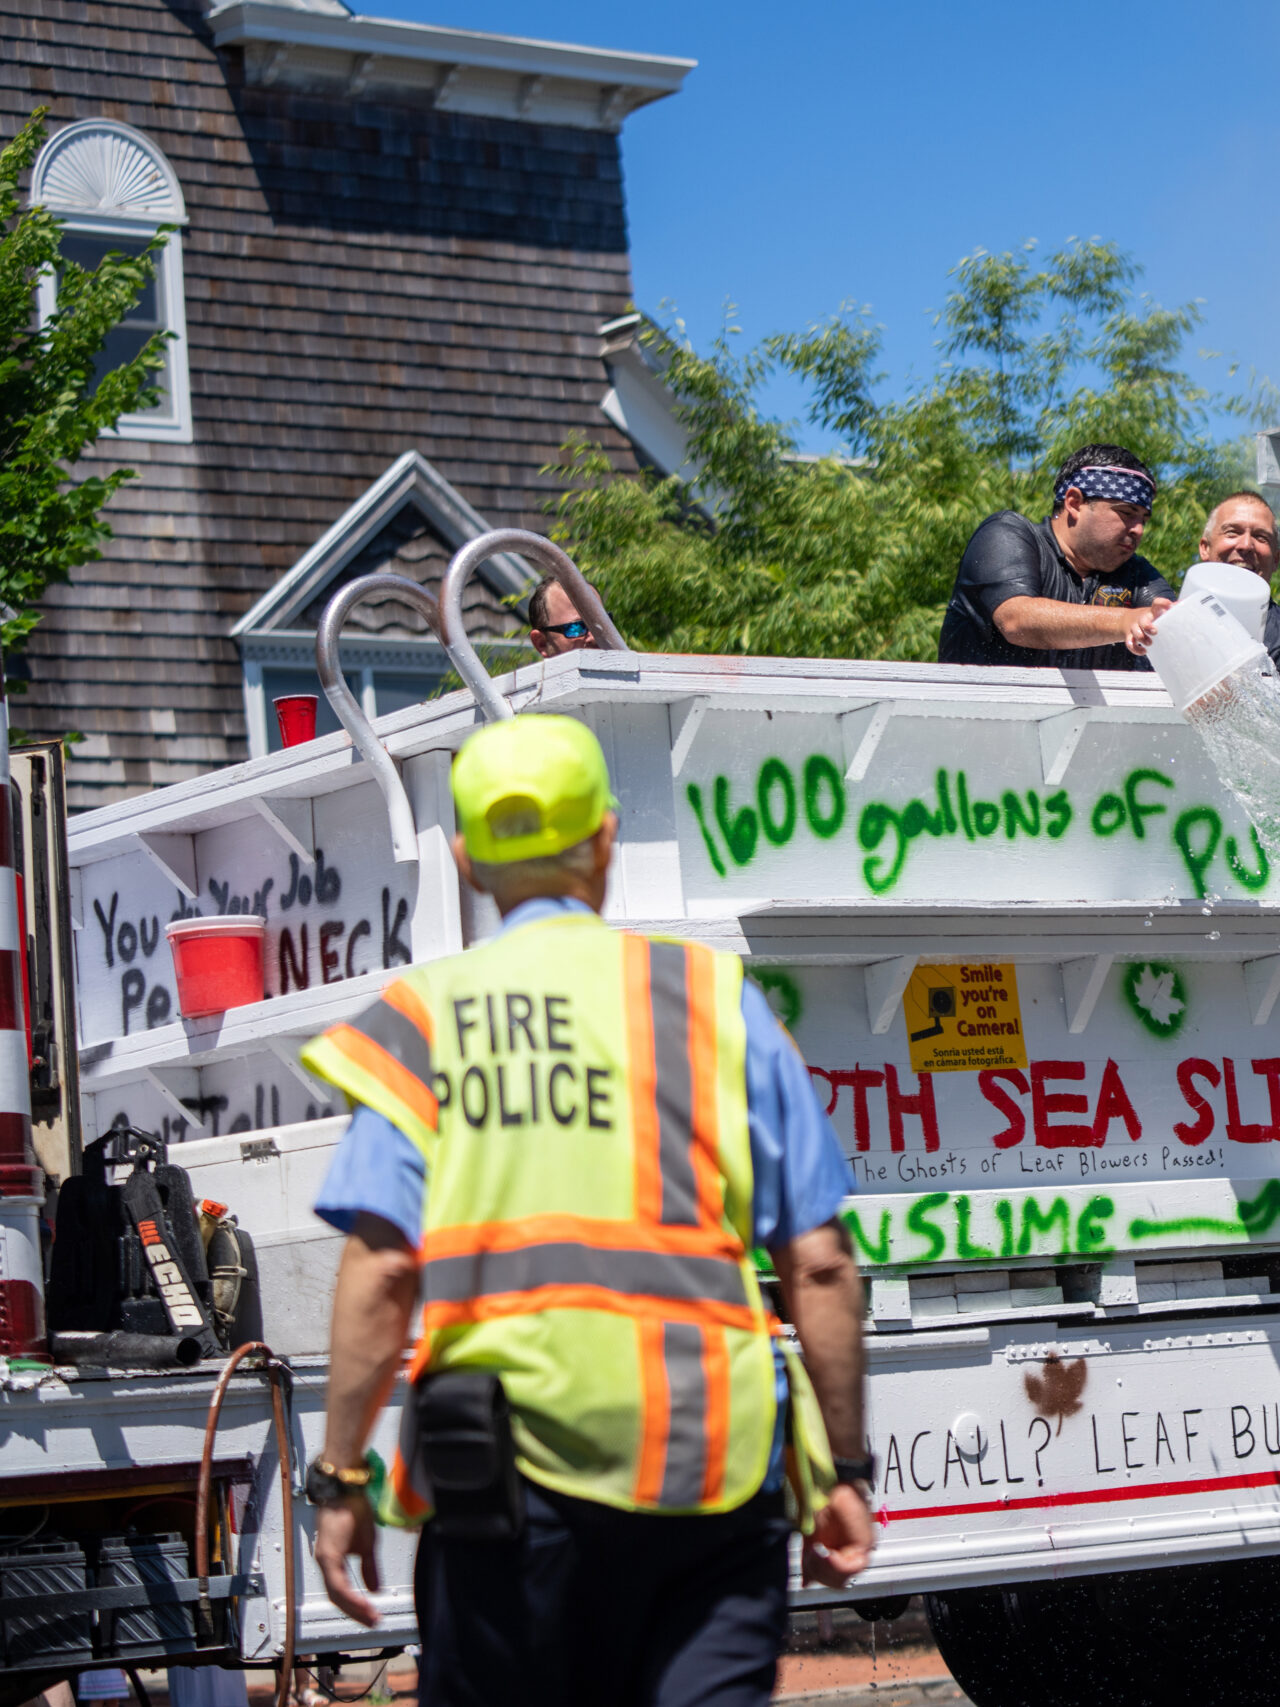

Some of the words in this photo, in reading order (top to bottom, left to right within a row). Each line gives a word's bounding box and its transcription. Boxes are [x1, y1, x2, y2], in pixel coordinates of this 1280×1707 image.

[687, 754, 845, 877] 1600
[859, 767, 1072, 894] gallons
[280, 848, 342, 911] Job
[279, 887, 412, 994] NECK
[961, 965, 1003, 984] Smile
[961, 985, 1008, 1007] you're
[453, 993, 574, 1060] FIRE
[957, 1018, 1020, 1037] Camera!
[977, 1006, 997, 1019] on
[924, 1060, 935, 1068] en
[962, 1046, 985, 1057] usted
[987, 1045, 1004, 1056] está
[978, 1057, 1142, 1149] SEA
[849, 1156, 888, 1183] The
[898, 1151, 967, 1183] Ghosts
[981, 1152, 1003, 1173] of
[1019, 1150, 1066, 1174] Leaf
[1080, 1151, 1148, 1177] Blowers
[1162, 1146, 1225, 1171] Passed!
[146, 1243, 204, 1326] ECHO
[865, 1416, 1051, 1494] ACALL?
[1091, 1409, 1203, 1474] LEAF
